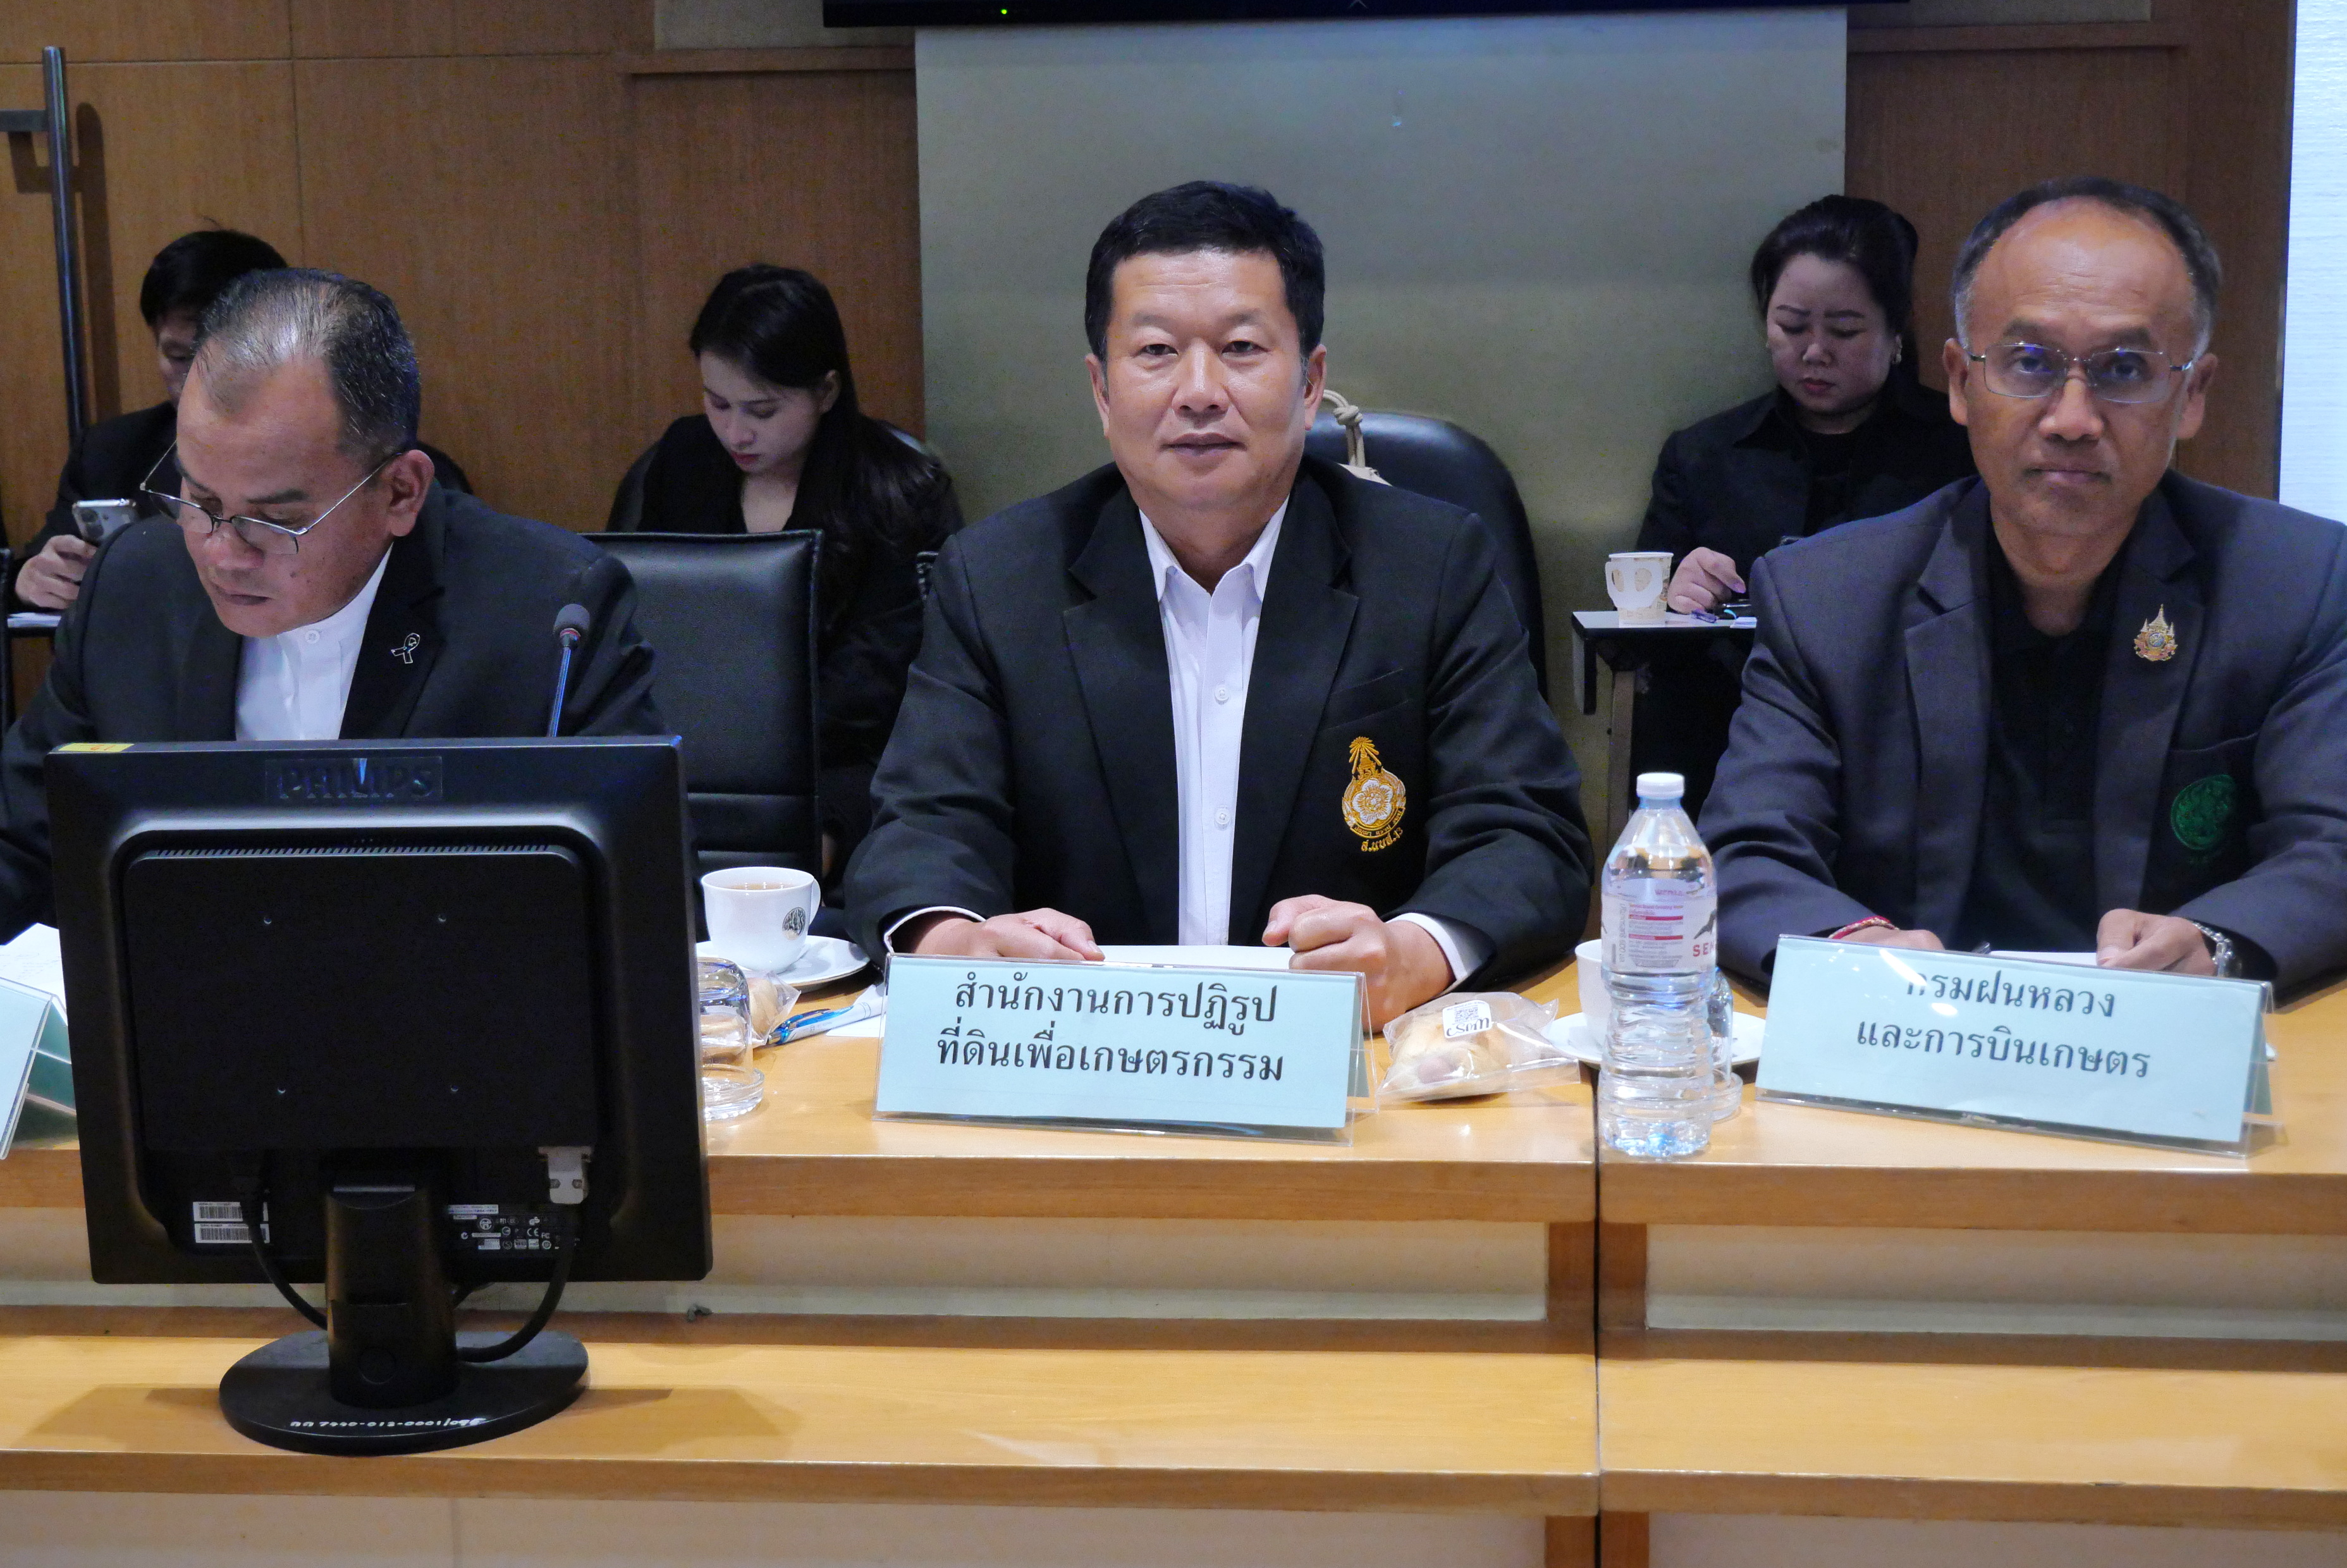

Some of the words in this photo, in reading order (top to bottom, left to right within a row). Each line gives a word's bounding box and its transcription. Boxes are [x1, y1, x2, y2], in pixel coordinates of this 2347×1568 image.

[955, 971, 1278, 1036] สำนักงานการปฏิรูป
[937, 1015, 1284, 1082] ที่ดินเพื่อเกษตรกรรม
[1857, 1020, 2151, 1079] และการบินเกษตร
